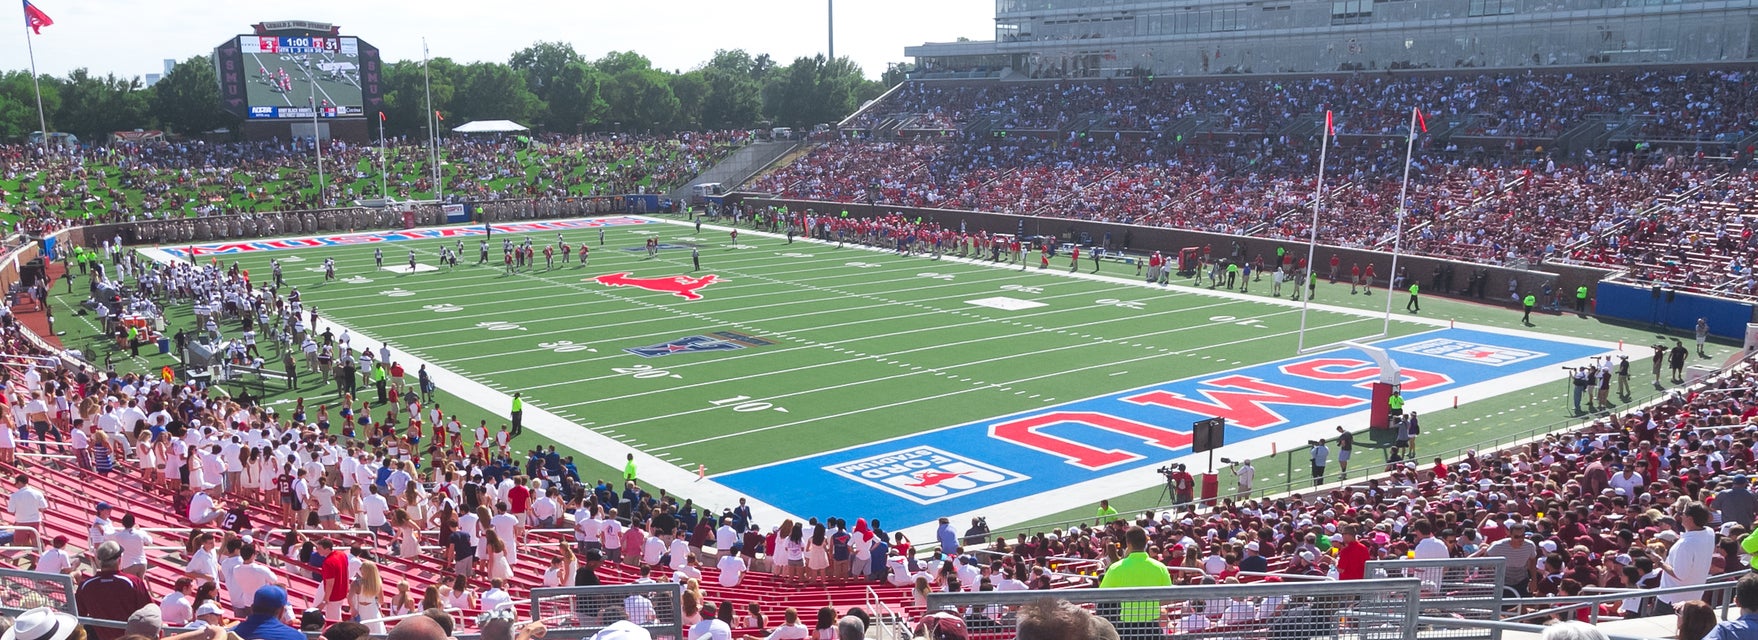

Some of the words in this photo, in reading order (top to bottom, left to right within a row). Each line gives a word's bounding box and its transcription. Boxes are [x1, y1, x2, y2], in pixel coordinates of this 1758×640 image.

[266, 40, 272, 49] 3
[287, 38, 308, 47] 1:00
[325, 41, 337, 50] 31
[225, 60, 238, 96] SMU
[367, 60, 378, 95] SMU
[176, 218, 648, 256] MUSTANGS
[538, 340, 588, 352] 30
[611, 364, 670, 379] 20
[709, 395, 773, 412] 10
[986, 357, 1456, 472] SMU
[840, 449, 933, 473] STADIUM
[861, 455, 953, 479] FORD
[280, 481, 289, 493] 12
[222, 512, 238, 529] 12
